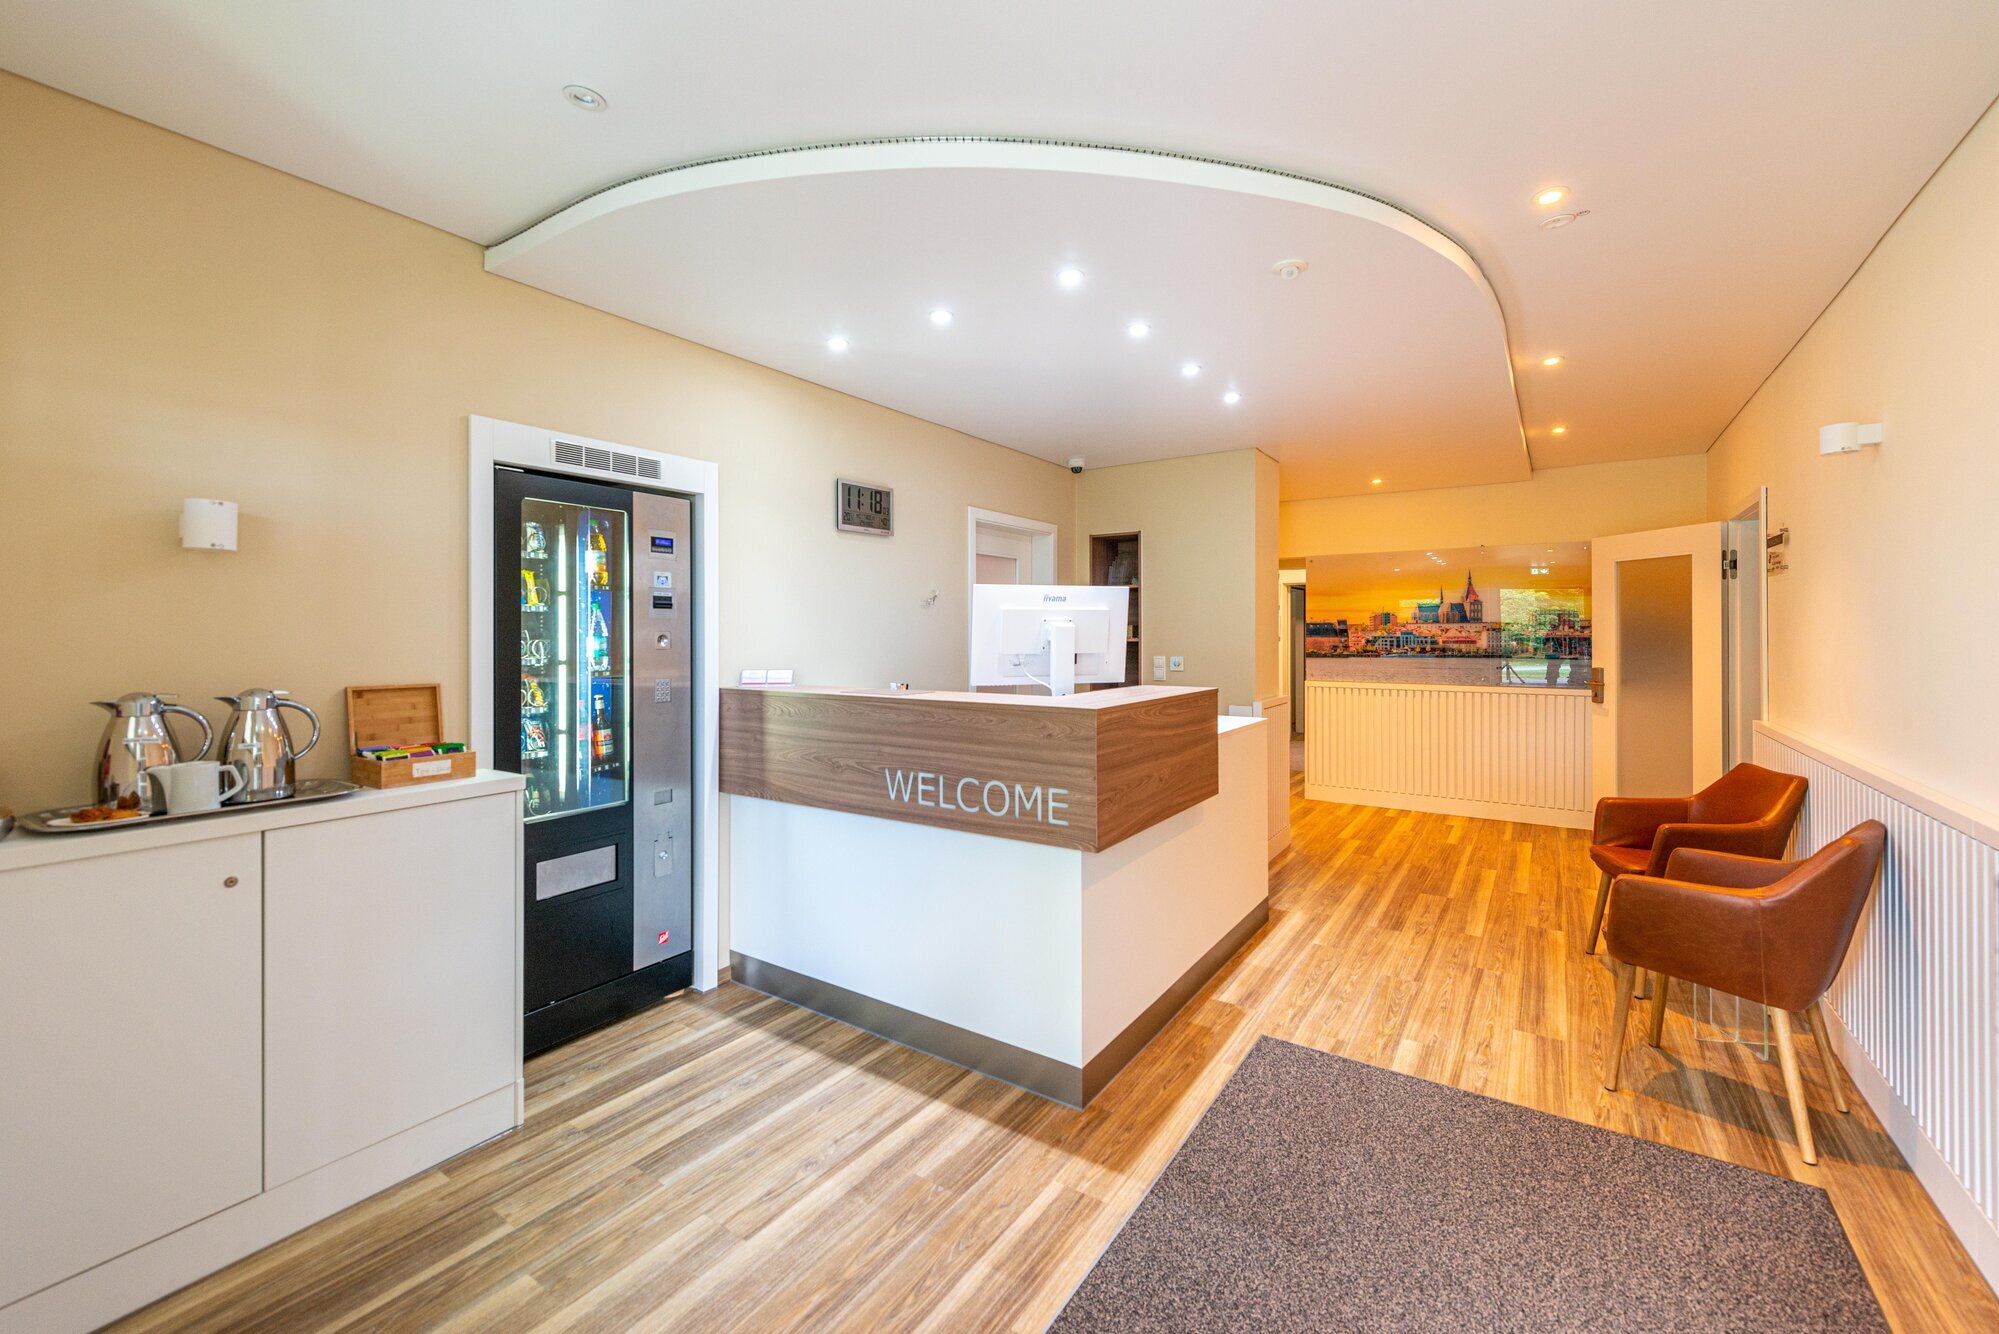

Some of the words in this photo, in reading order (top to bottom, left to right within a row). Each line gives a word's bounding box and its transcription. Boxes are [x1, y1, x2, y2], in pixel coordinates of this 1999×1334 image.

[848, 486, 882, 514] 11:18
[1043, 593, 1067, 603] iiyama
[884, 767, 1070, 827] WELCOME
